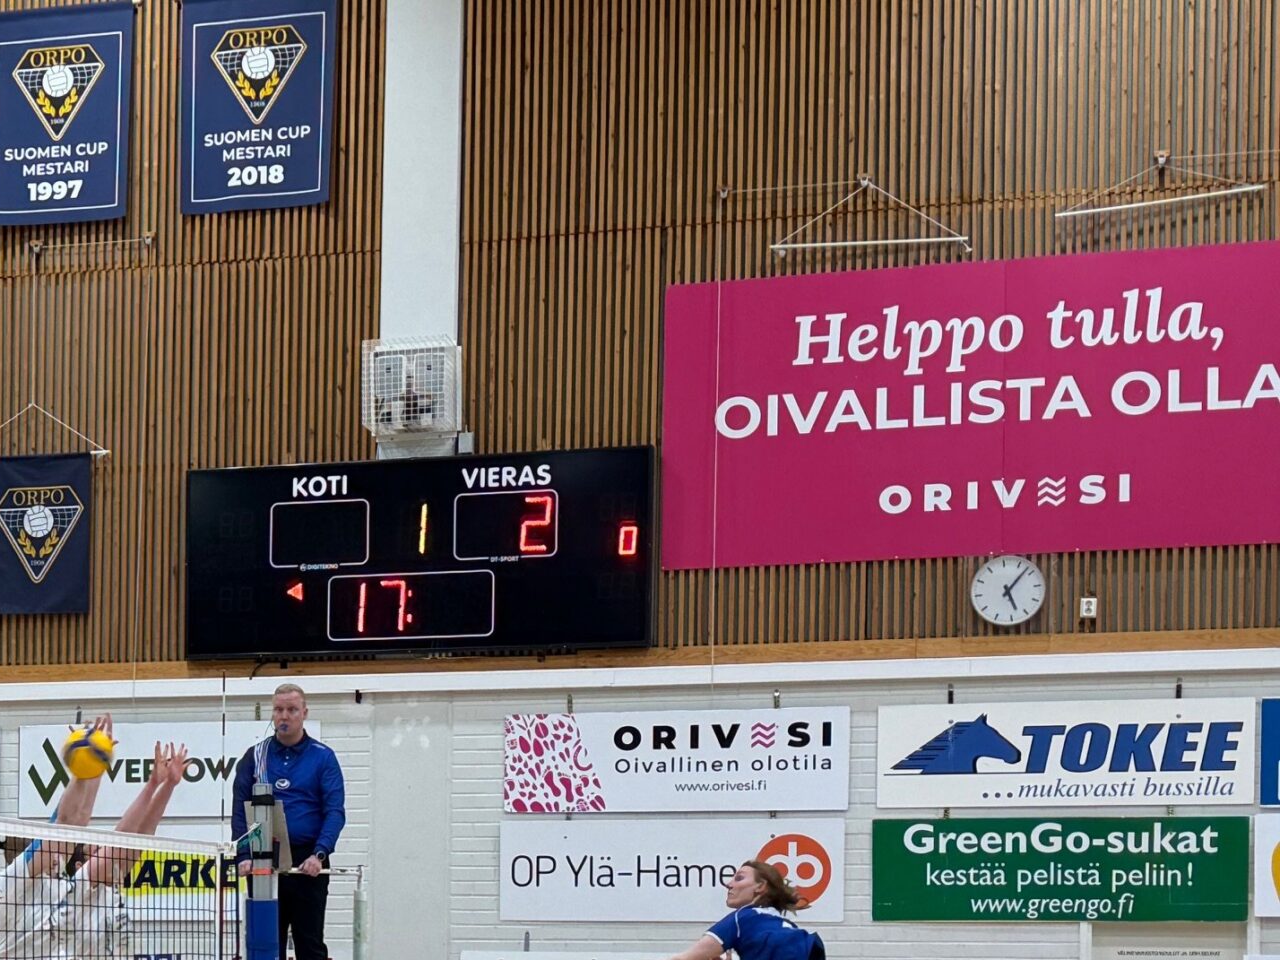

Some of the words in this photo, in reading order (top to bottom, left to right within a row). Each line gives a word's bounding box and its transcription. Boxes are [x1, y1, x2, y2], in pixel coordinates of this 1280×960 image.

[228, 28, 288, 48] ORPO
[30, 47, 86, 67] ORPO
[204, 129, 272, 147] SUOMEN
[276, 125, 311, 141] CUP
[4, 145, 71, 161] SUOMEN
[75, 142, 109, 157] CUP
[222, 144, 291, 162] MESTARI
[22, 161, 89, 177] MESTARI
[227, 165, 284, 186] 2018
[27, 179, 83, 201] 1997
[792, 305, 1024, 376] Helppo
[1046, 285, 1225, 351] tulla,
[714, 374, 1092, 440] OIVALLISTA
[1111, 362, 1280, 417] OLLA
[292, 475, 348, 498] KOTI
[462, 464, 552, 489] VIERAS
[13, 488, 64, 505] ORPO
[418, 503, 428, 555] 1
[520, 496, 552, 552] 2
[618, 525, 638, 556] 0
[1022, 721, 1244, 773] TOKEE
[614, 756, 740, 774] Oivallinen
[751, 754, 832, 772] olotila
[675, 779, 767, 793] www.orivesi.fi
[1143, 776, 1235, 798] bussilla
[903, 822, 1219, 854] GreenGo-sukat
[511, 855, 557, 887] OP
[926, 862, 1007, 887] kestää
[1017, 862, 1102, 892] pelistä
[970, 893, 1135, 919] www.greengo.fi
